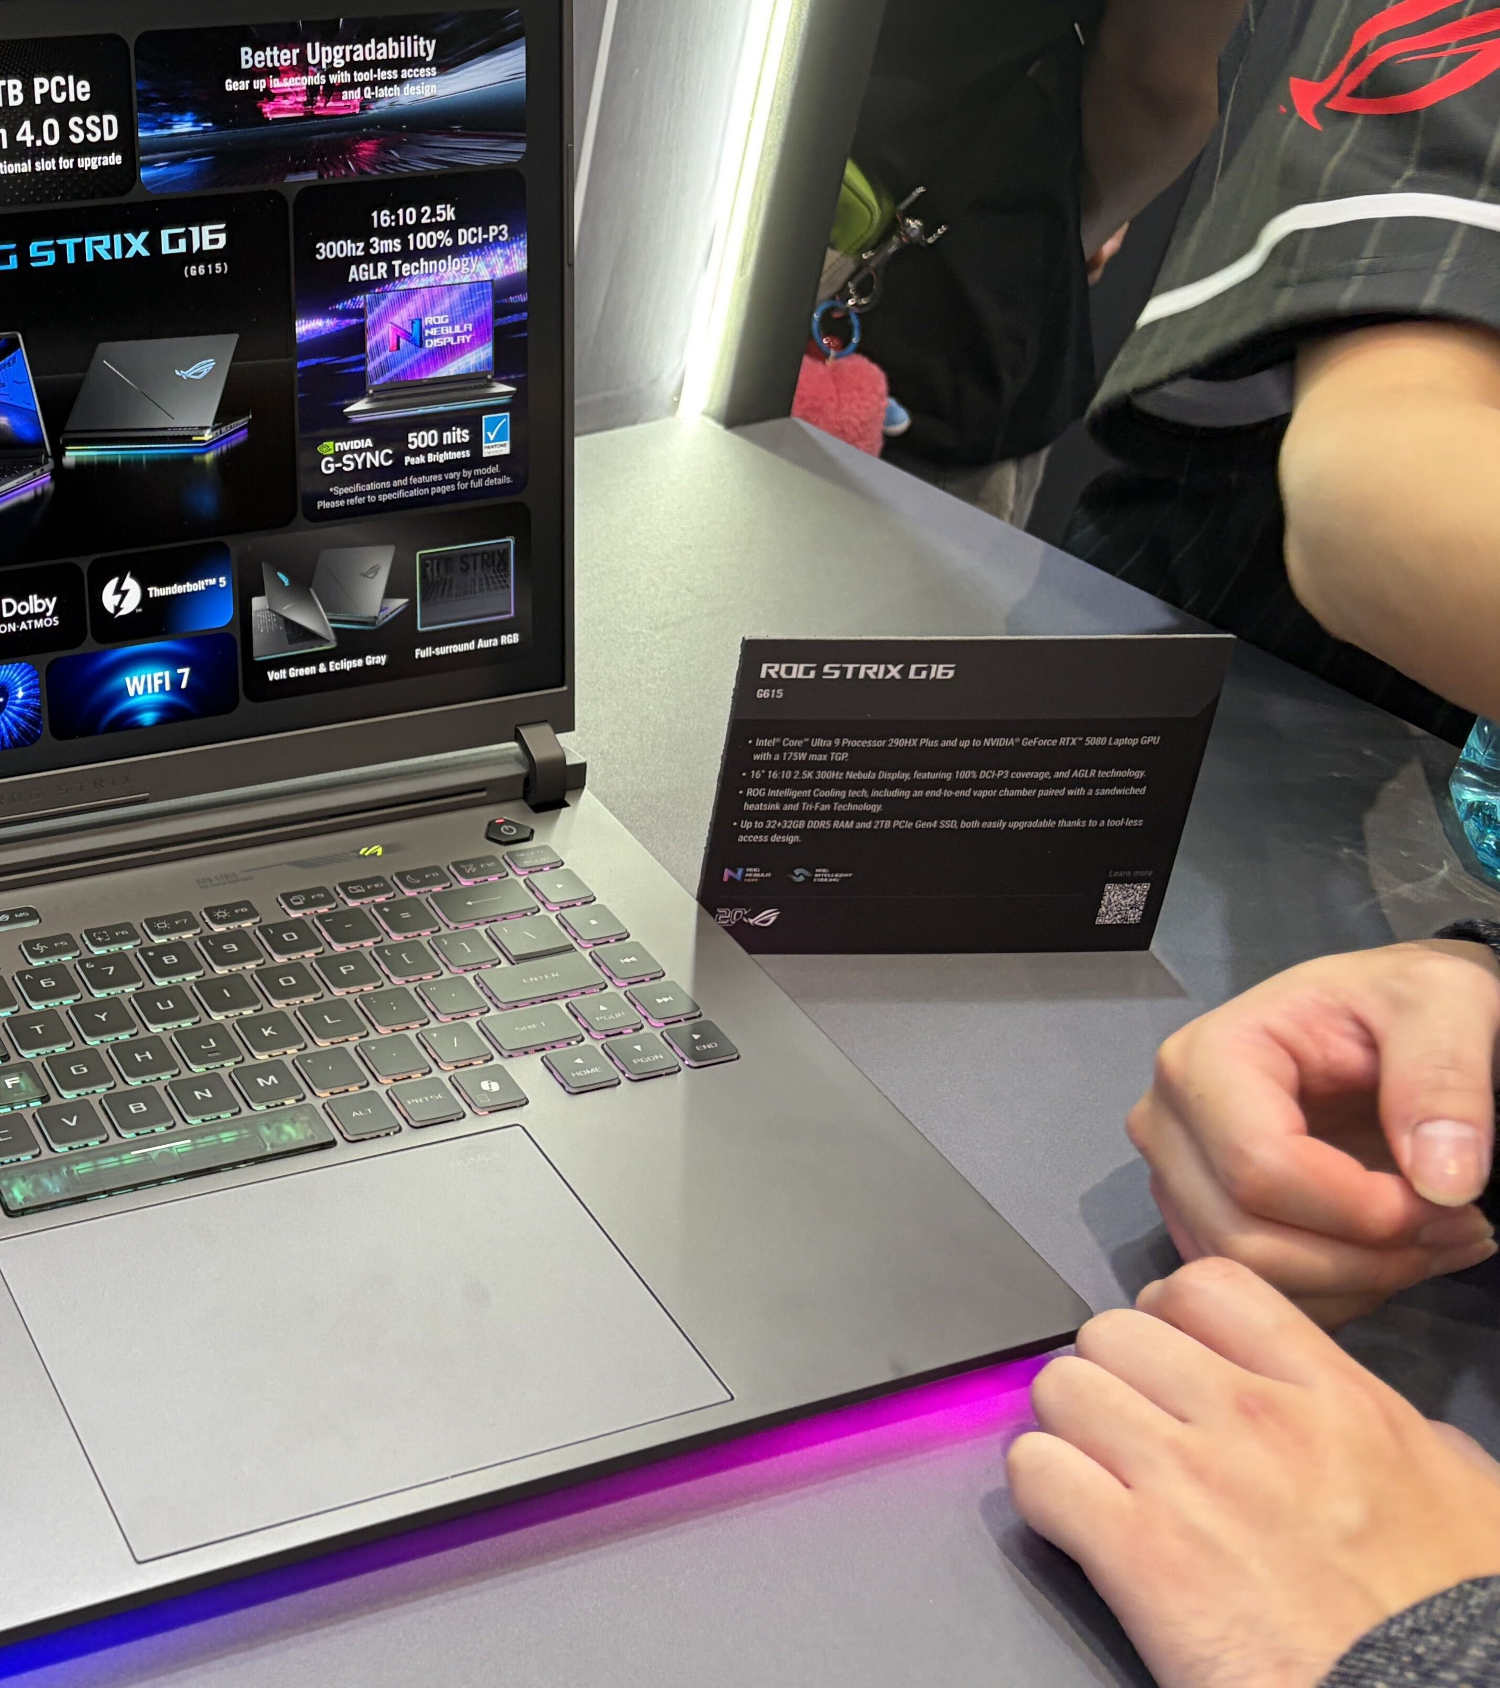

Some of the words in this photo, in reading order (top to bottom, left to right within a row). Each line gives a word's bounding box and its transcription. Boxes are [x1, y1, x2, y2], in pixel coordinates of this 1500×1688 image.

[240, 46, 300, 69] Better
[306, 34, 437, 69] Upgradability
[33, 75, 91, 105] PCIe
[224, 76, 250, 92] Gear
[253, 76, 266, 92] up
[283, 72, 326, 87] seconds
[328, 71, 351, 84] with
[353, 68, 398, 84] tool-less
[401, 66, 437, 79] access
[341, 87, 362, 101] and
[363, 84, 400, 100] Q-latch
[403, 83, 437, 97] design
[16, 118, 60, 147] 4.0
[68, 114, 119, 144] SSD
[34, 157, 56, 172] slot
[58, 156, 75, 170] for
[77, 152, 122, 171] upgrade
[371, 207, 416, 228] 16:10
[420, 204, 456, 223] 2.5k
[30, 231, 149, 269] STRIX
[160, 223, 227, 255] G16
[315, 240, 365, 260] 300hz
[369, 237, 401, 255] 3ms
[407, 230, 453, 250] 100%
[458, 224, 509, 246] DCI-P3
[183, 262, 228, 278] (G615)
[348, 262, 388, 282] AGLR
[392, 254, 478, 278] Technology
[335, 438, 373, 452] NVIDIA
[407, 430, 438, 450] 500
[442, 427, 470, 445] nits
[320, 449, 393, 475] G-SYNC
[404, 455, 426, 466] Peak
[427, 449, 471, 464] Brightness
[147, 578, 216, 598] Thunderbolt™
[219, 577, 226, 588] 5
[1, 595, 57, 618] Dolby
[414, 641, 475, 659] Full-surround
[477, 637, 498, 649] Aura
[500, 633, 519, 646] RGB
[267, 668, 286, 682] Volt
[288, 665, 316, 678] Green
[319, 662, 326, 673] &
[329, 657, 363, 672] Eclipse
[366, 654, 387, 667] Gray
[760, 663, 817, 679] ROG
[822, 663, 904, 679] STRIX
[908, 663, 956, 680] G16
[125, 670, 170, 697] WIFI
[177, 667, 190, 689] 7
[756, 689, 784, 699] G615
[811, 738, 832, 747] Ultra
[834, 738, 840, 747] 9
[841, 738, 886, 748] Processor
[888, 738, 917, 747] 290HX
[920, 738, 938, 747] Plus
[941, 738, 957, 747] and
[959, 739, 970, 749] up
[972, 738, 982, 746] to
[1022, 737, 1057, 747] GeForce
[1084, 736, 1107, 746] 5080
[1108, 736, 1139, 748] Laptop
[1140, 736, 1160, 745] GPU
[1109, 869, 1131, 878] Learn
[695, 1041, 718, 1051] END
